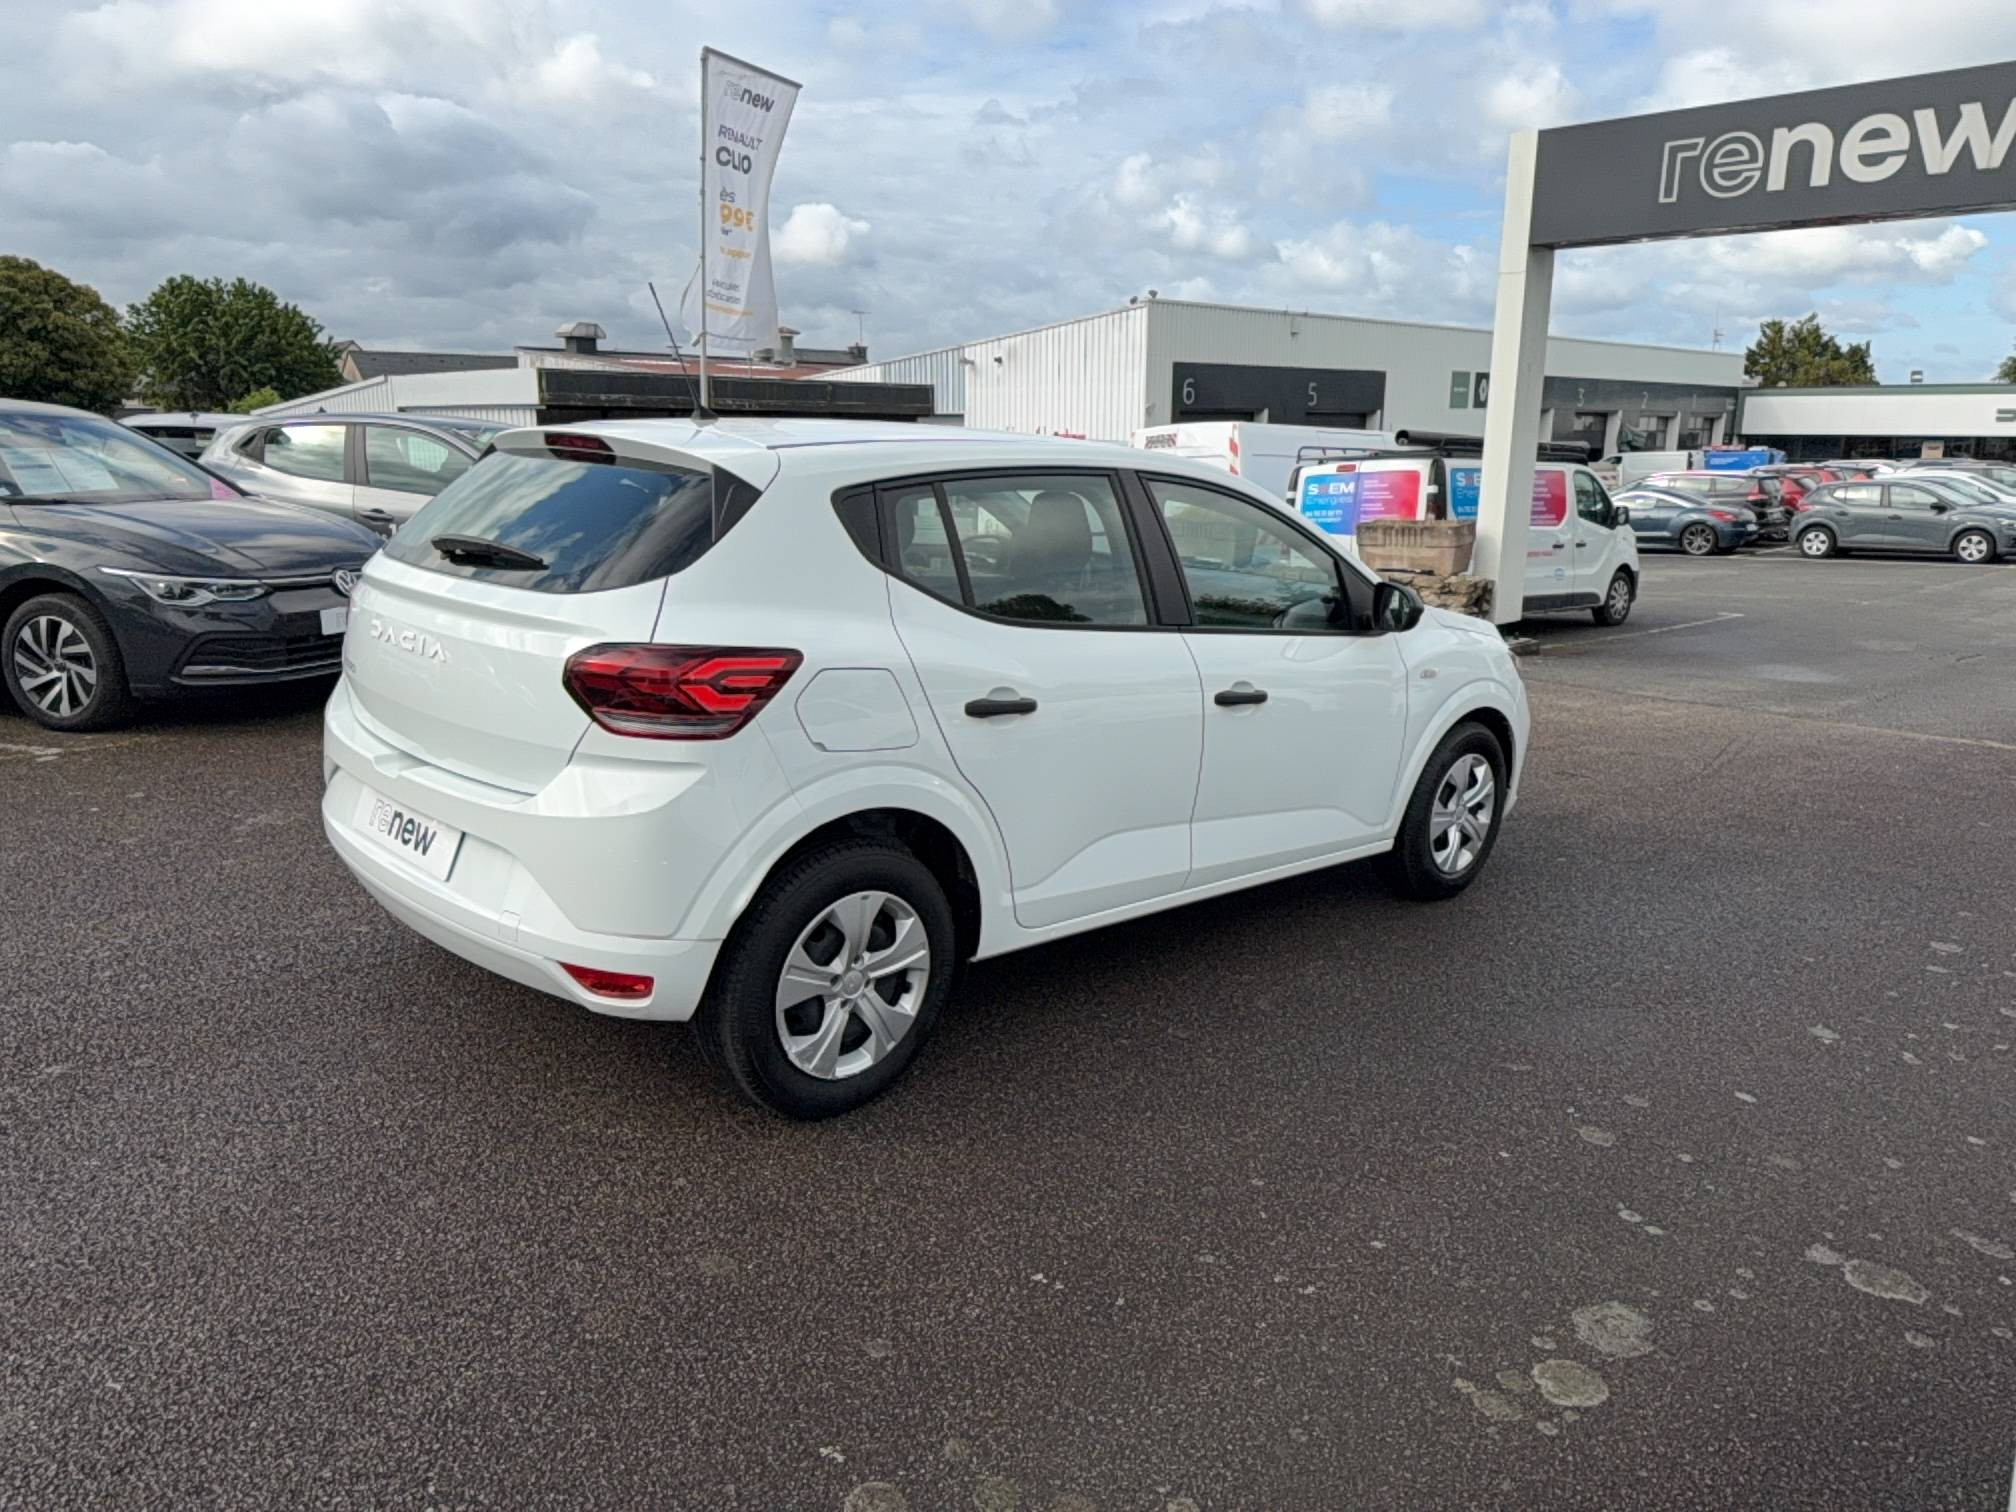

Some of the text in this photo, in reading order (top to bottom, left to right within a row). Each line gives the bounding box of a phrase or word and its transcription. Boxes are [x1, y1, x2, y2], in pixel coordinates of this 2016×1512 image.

[724, 80, 775, 113] renew
[718, 124, 763, 150] RENAULT
[1658, 97, 2016, 203] renew
[716, 145, 752, 175] CLIO
[1182, 378, 1195, 405] 6
[1307, 382, 1318, 407] 5
[1576, 387, 1586, 408] 3
[1641, 391, 1649, 409] 2
[369, 617, 450, 664] DACIA
[368, 798, 438, 857] renew
